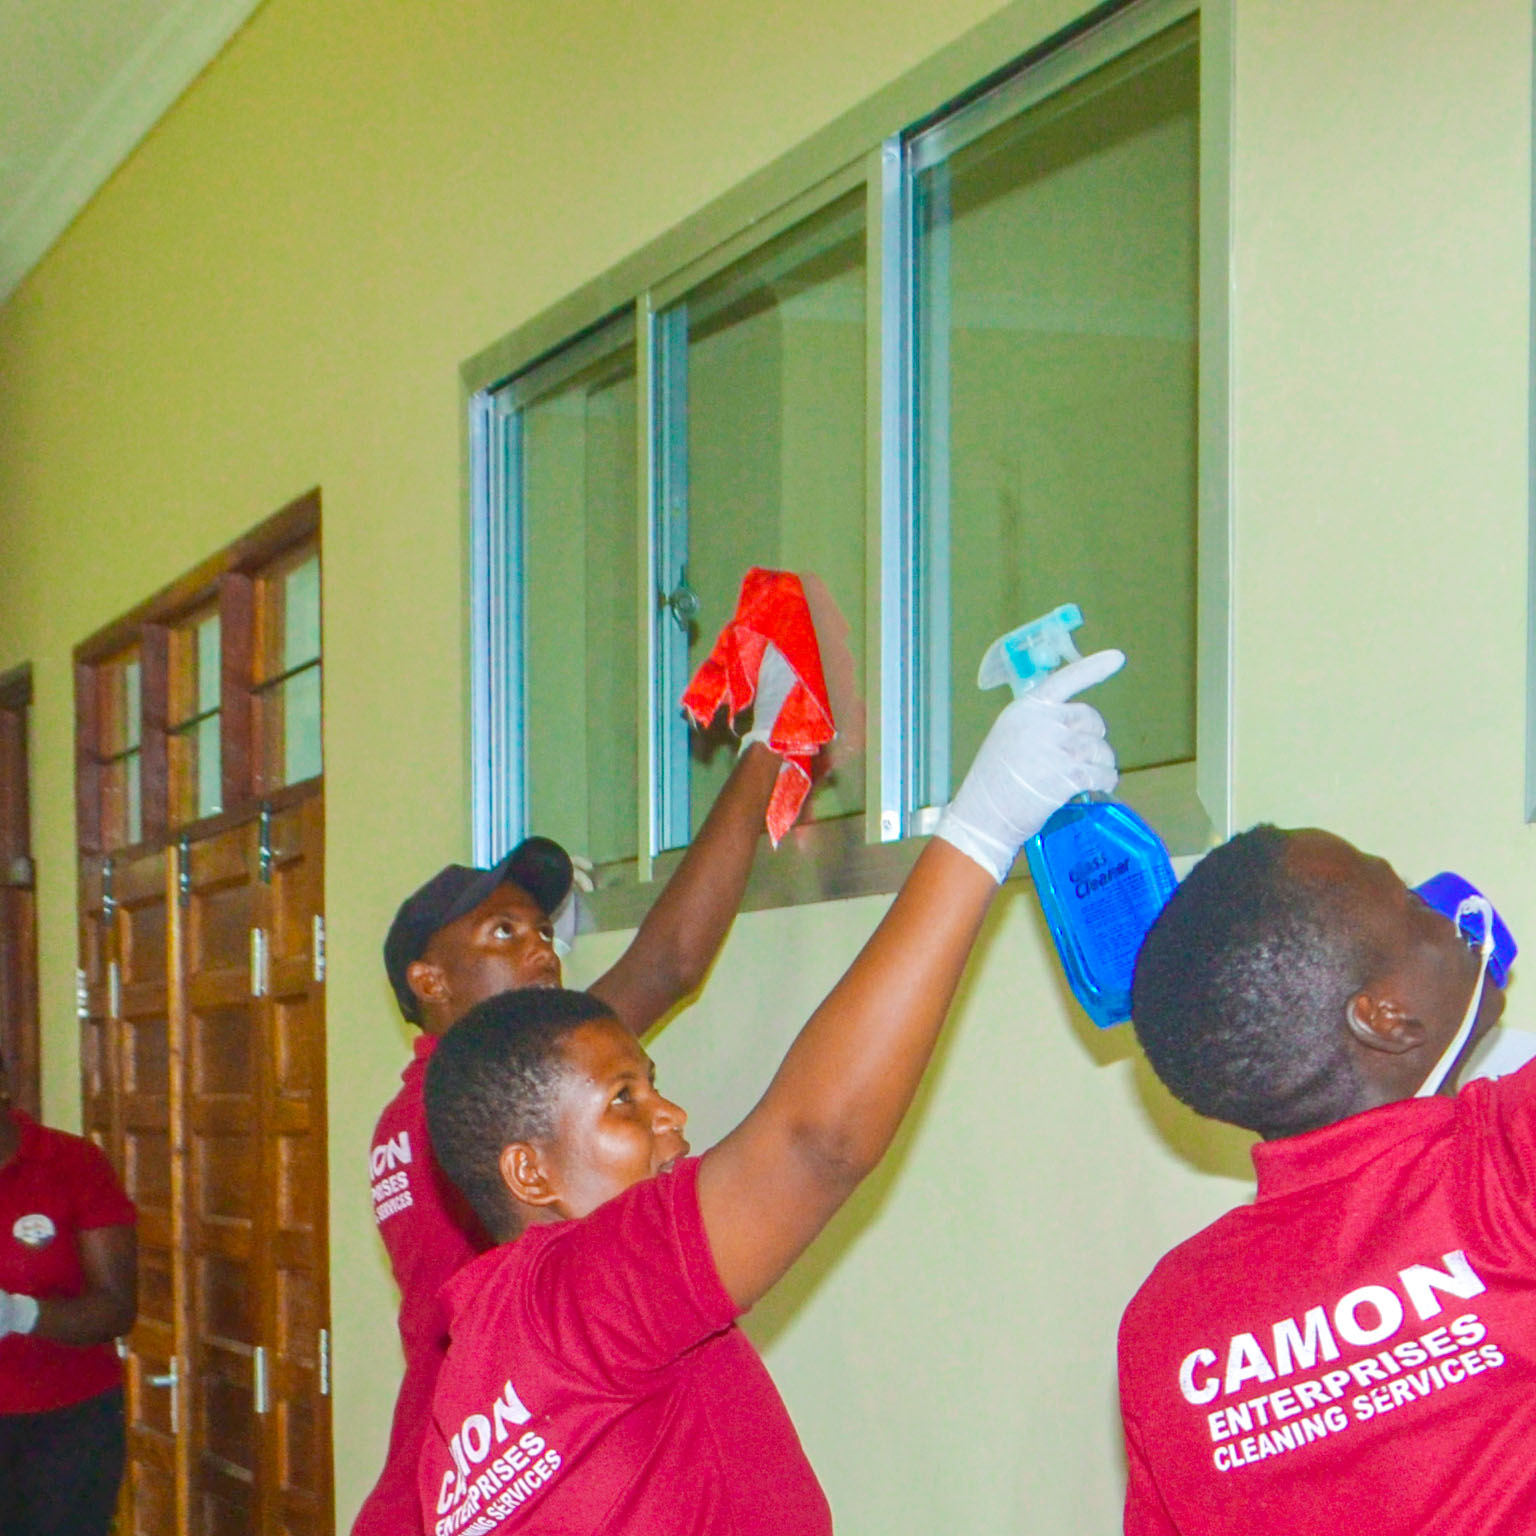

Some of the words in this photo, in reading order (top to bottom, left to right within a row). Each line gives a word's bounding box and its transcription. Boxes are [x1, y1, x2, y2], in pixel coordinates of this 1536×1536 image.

[1075, 858, 1130, 899] Cleaner
[1179, 1249, 1487, 1406] CAMON
[1207, 1313, 1487, 1442] ENTERPRISES
[1213, 1405, 1349, 1472] CLEANING
[1351, 1343, 1506, 1421] SERVICES
[486, 1449, 563, 1521] SERVICES
